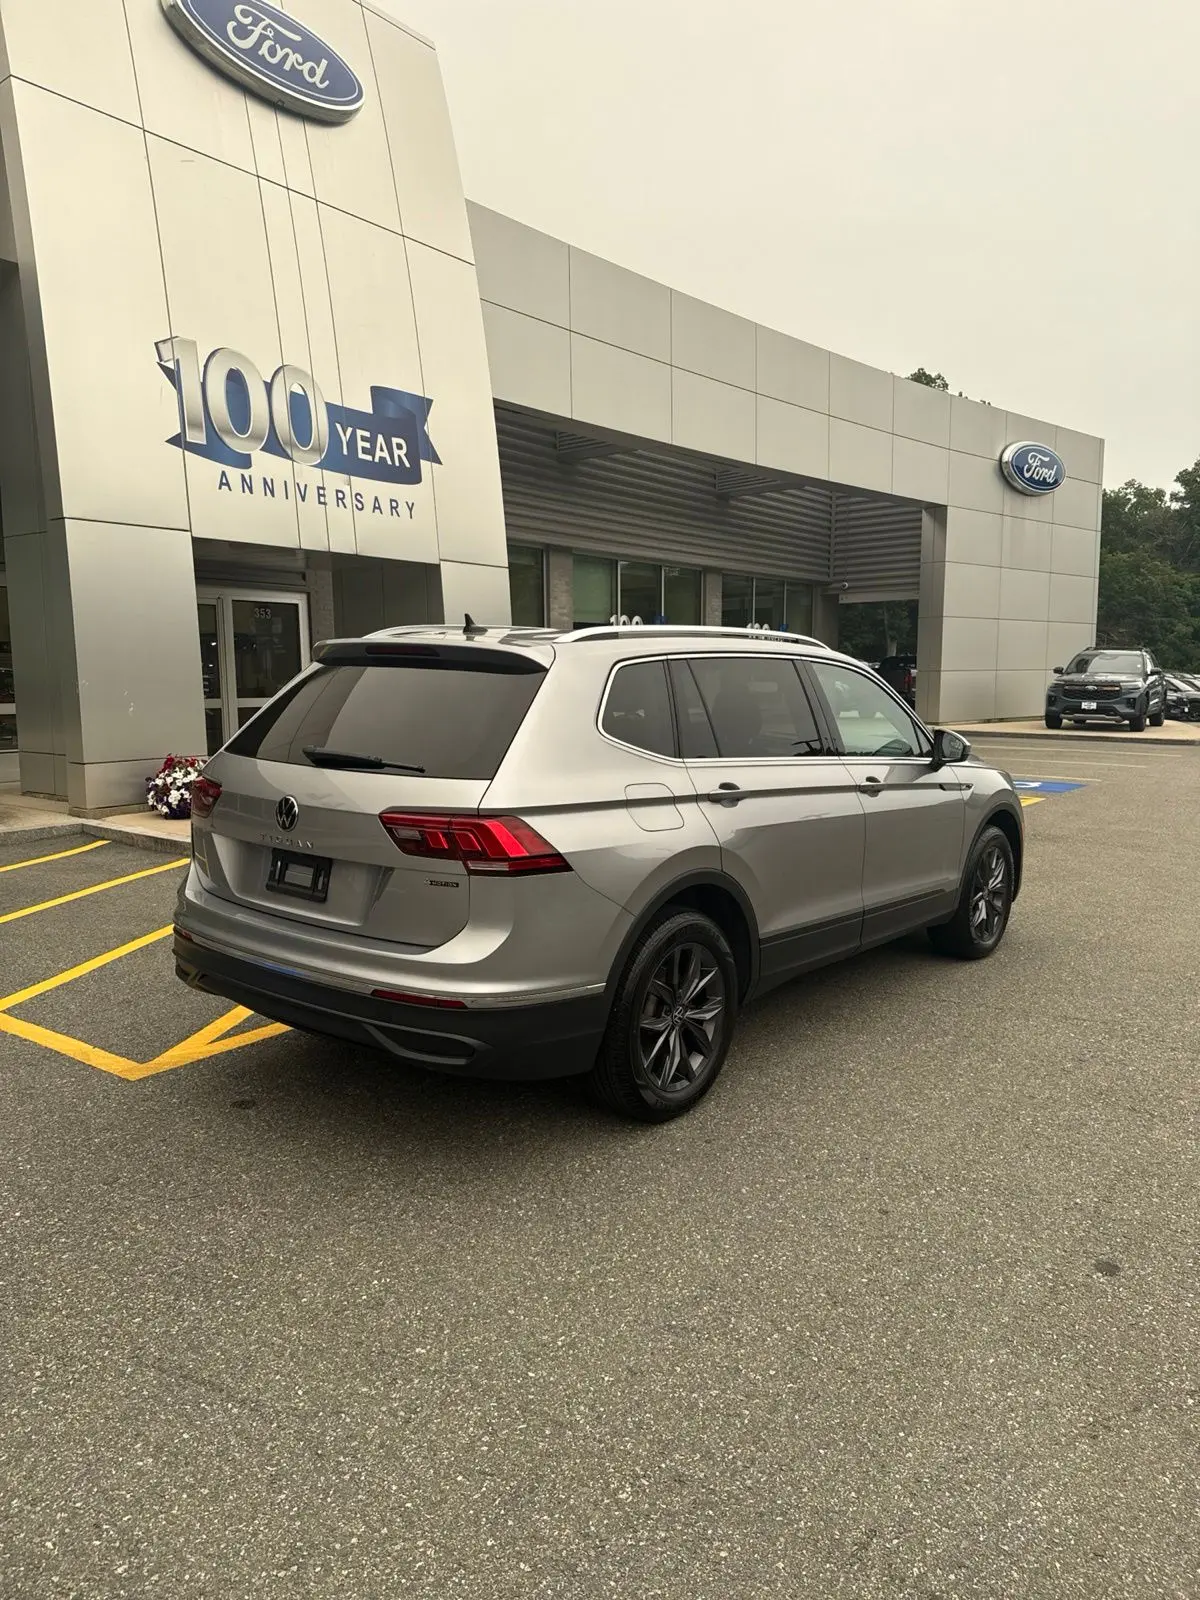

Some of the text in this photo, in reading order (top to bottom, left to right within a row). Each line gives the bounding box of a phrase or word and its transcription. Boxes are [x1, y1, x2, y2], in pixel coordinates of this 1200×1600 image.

[227, 4, 330, 89] Ford
[154, 336, 411, 468] 100 YEAR
[1023, 451, 1057, 483] Ford
[218, 471, 415, 519] ANNIVERSARY
[254, 607, 271, 620] 353
